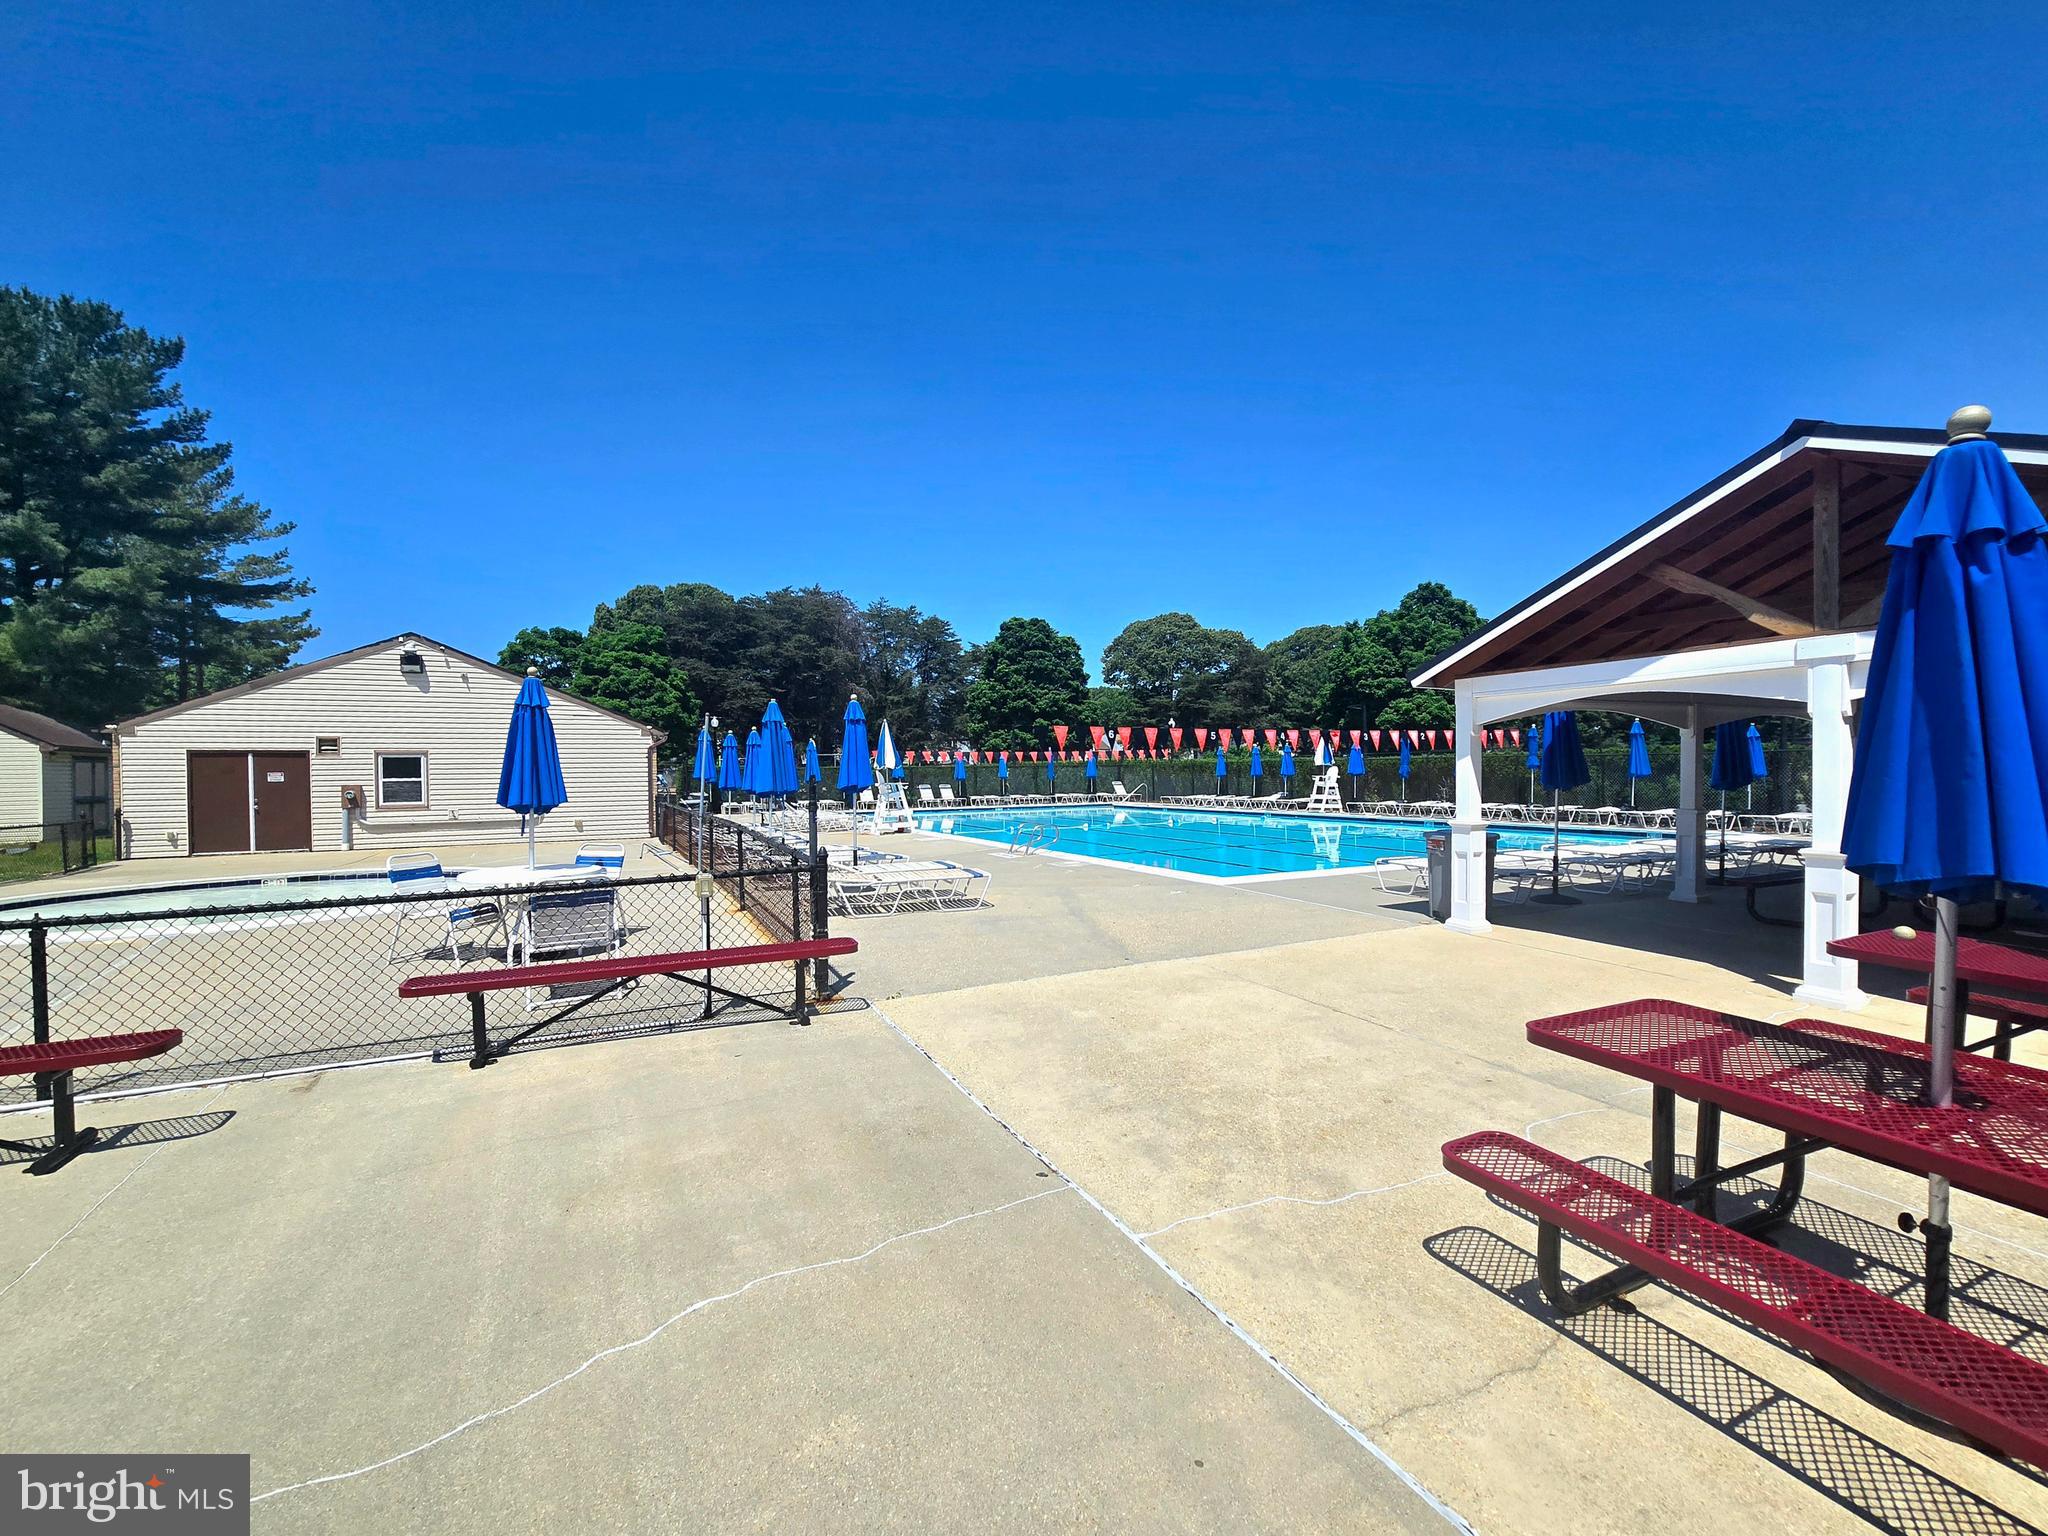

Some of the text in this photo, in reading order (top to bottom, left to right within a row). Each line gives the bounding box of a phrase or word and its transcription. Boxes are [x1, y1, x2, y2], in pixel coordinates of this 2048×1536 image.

[1108, 730, 1115, 739] 6
[1210, 732, 1216, 740] 5
[1280, 732, 1286, 740] 4
[1363, 732, 1369, 741] 3
[1420, 732, 1426, 740] 2
